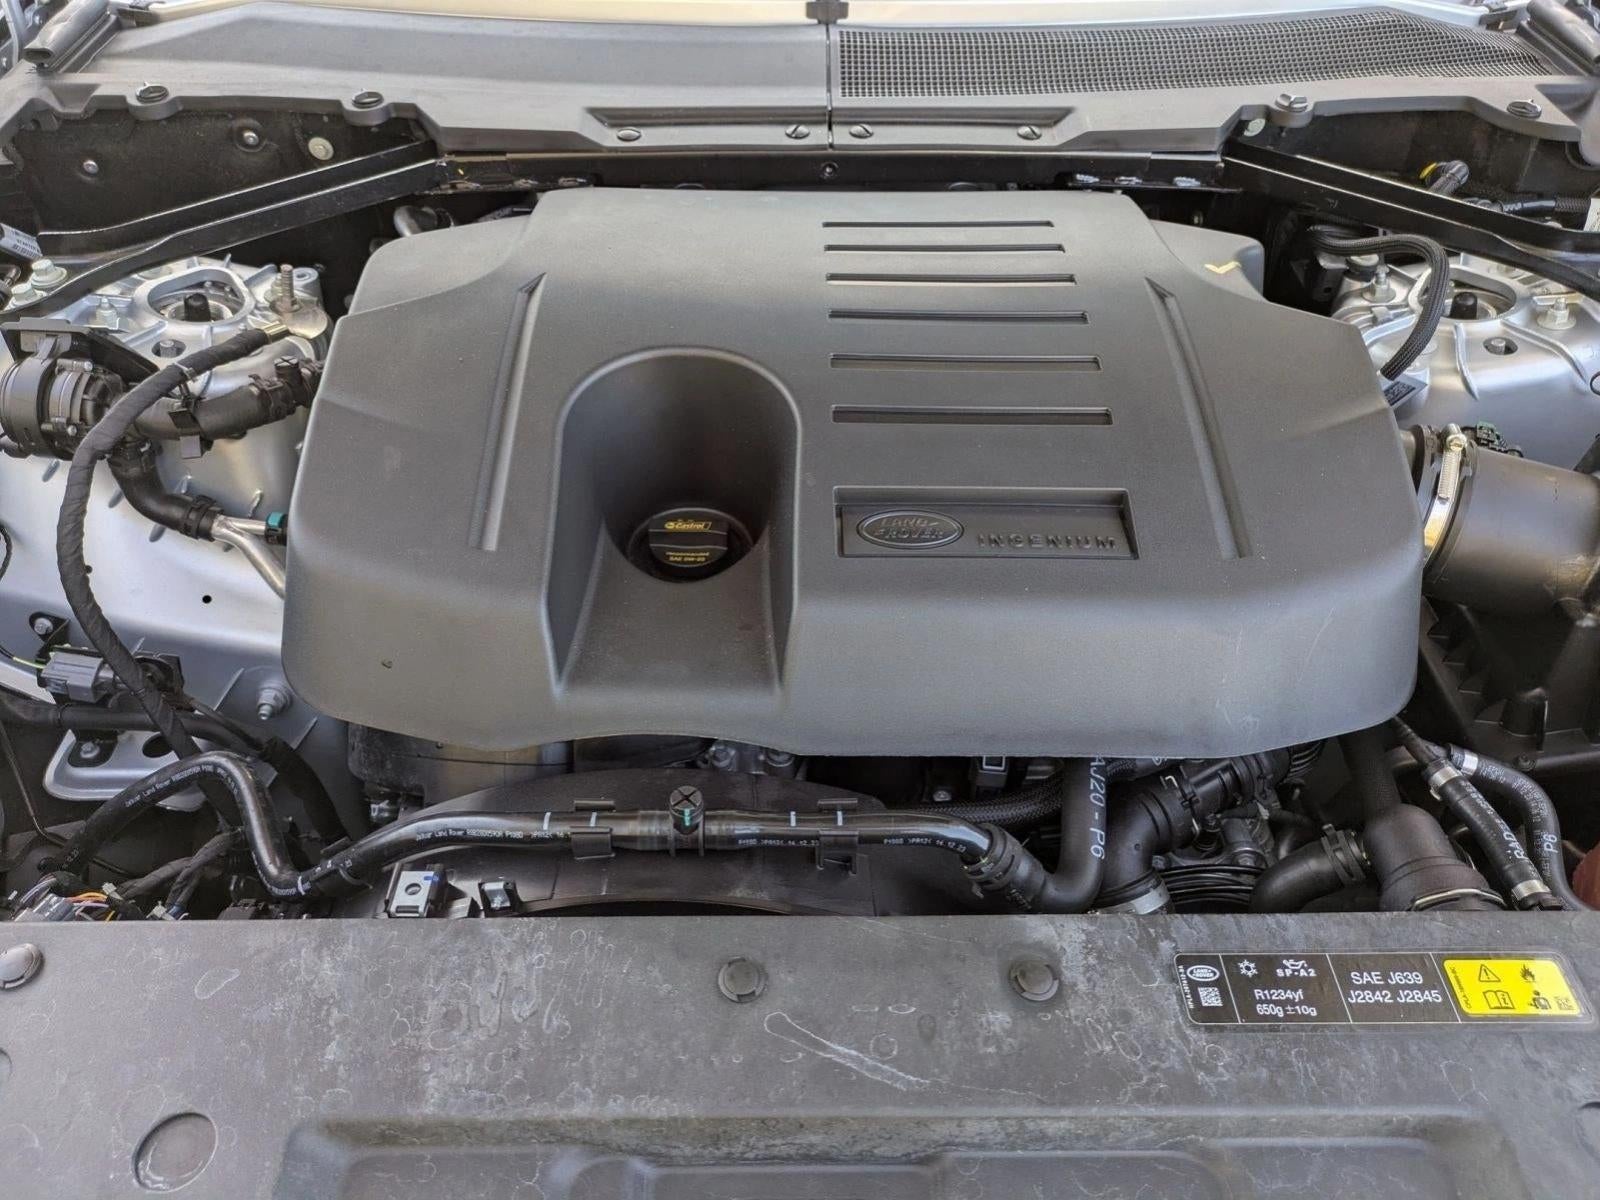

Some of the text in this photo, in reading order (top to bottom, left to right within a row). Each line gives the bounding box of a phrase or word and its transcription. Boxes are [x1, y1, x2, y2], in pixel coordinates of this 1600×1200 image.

[880, 518, 929, 528] LAND
[882, 528, 945, 540] ROVER
[977, 534, 1117, 549] INGENIUM
[1090, 827, 1105, 860] P6
[1351, 970, 1424, 985] SAE J639
[1253, 989, 1305, 1003] R1234yf
[1347, 990, 1443, 1004] J2842 J2845
[1256, 1003, 1285, 1018] 650g
